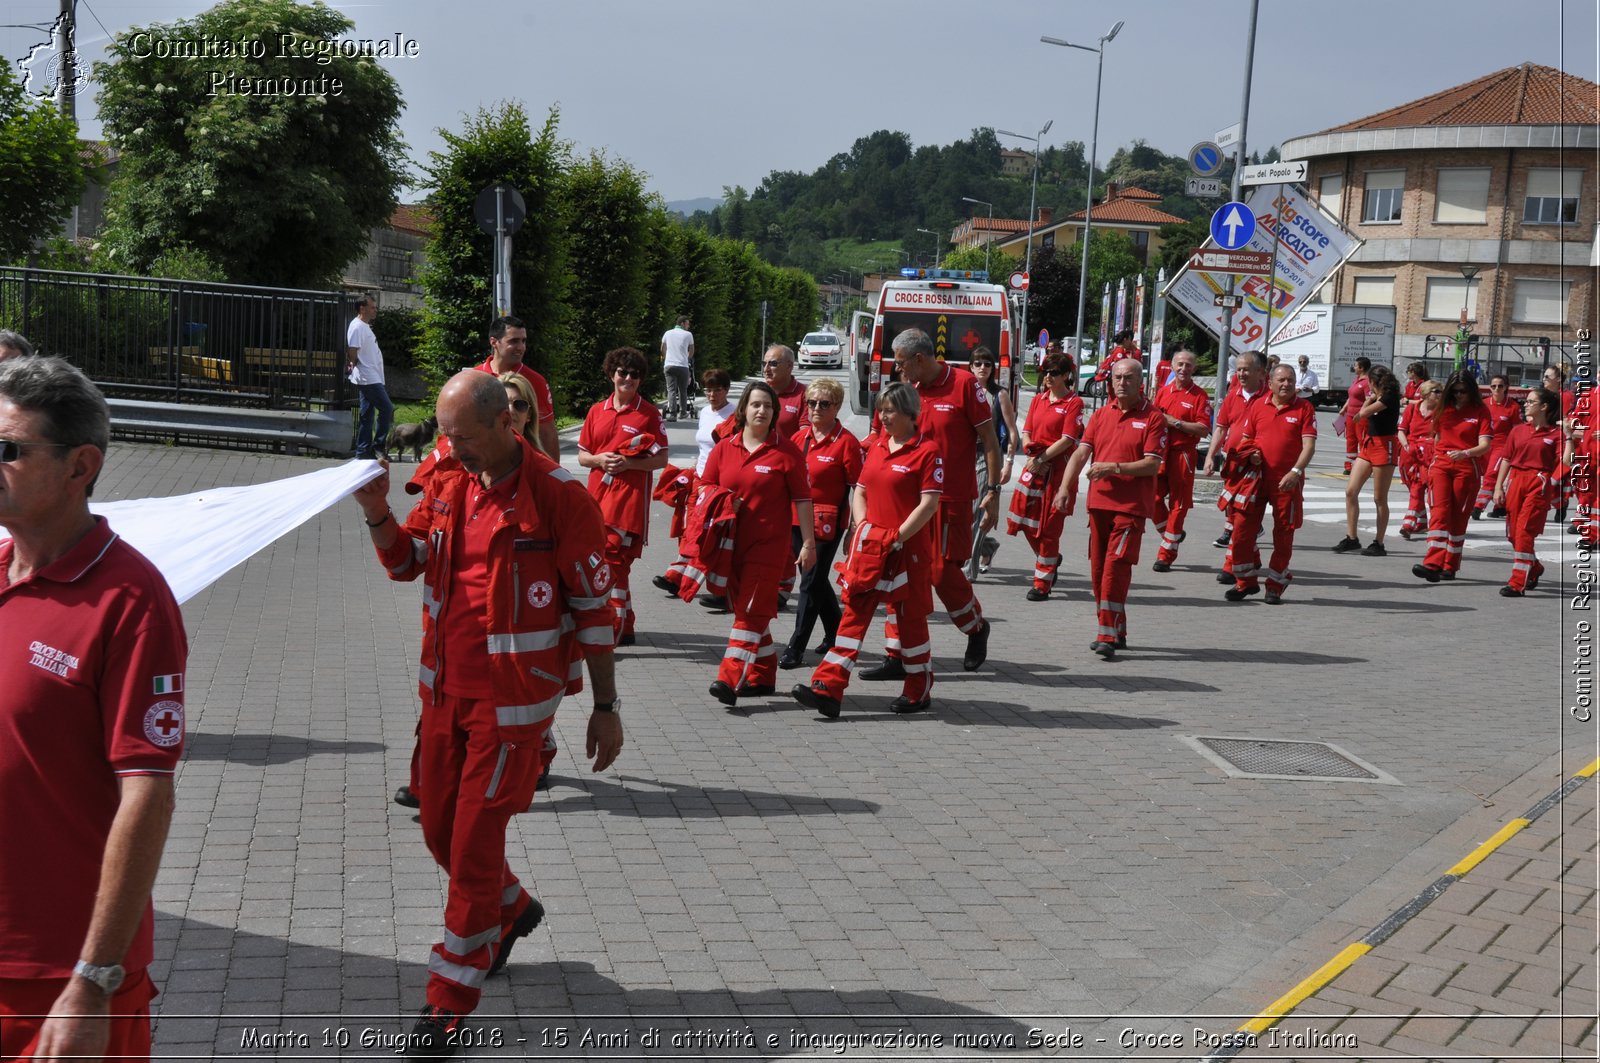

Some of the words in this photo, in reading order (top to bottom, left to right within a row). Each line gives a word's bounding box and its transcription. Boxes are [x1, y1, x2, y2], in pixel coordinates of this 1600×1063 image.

[1257, 169, 1267, 178] del
[1269, 168, 1291, 178] Popolo
[1288, 272, 1305, 287] 2018
[894, 292, 923, 304] CROCE
[925, 294, 953, 305] ROSSA
[955, 296, 993, 307] ITALIANA
[29, 640, 56, 659] CROCE
[53, 650, 80, 669] ROSSA
[29, 653, 69, 678] ITALIANA
